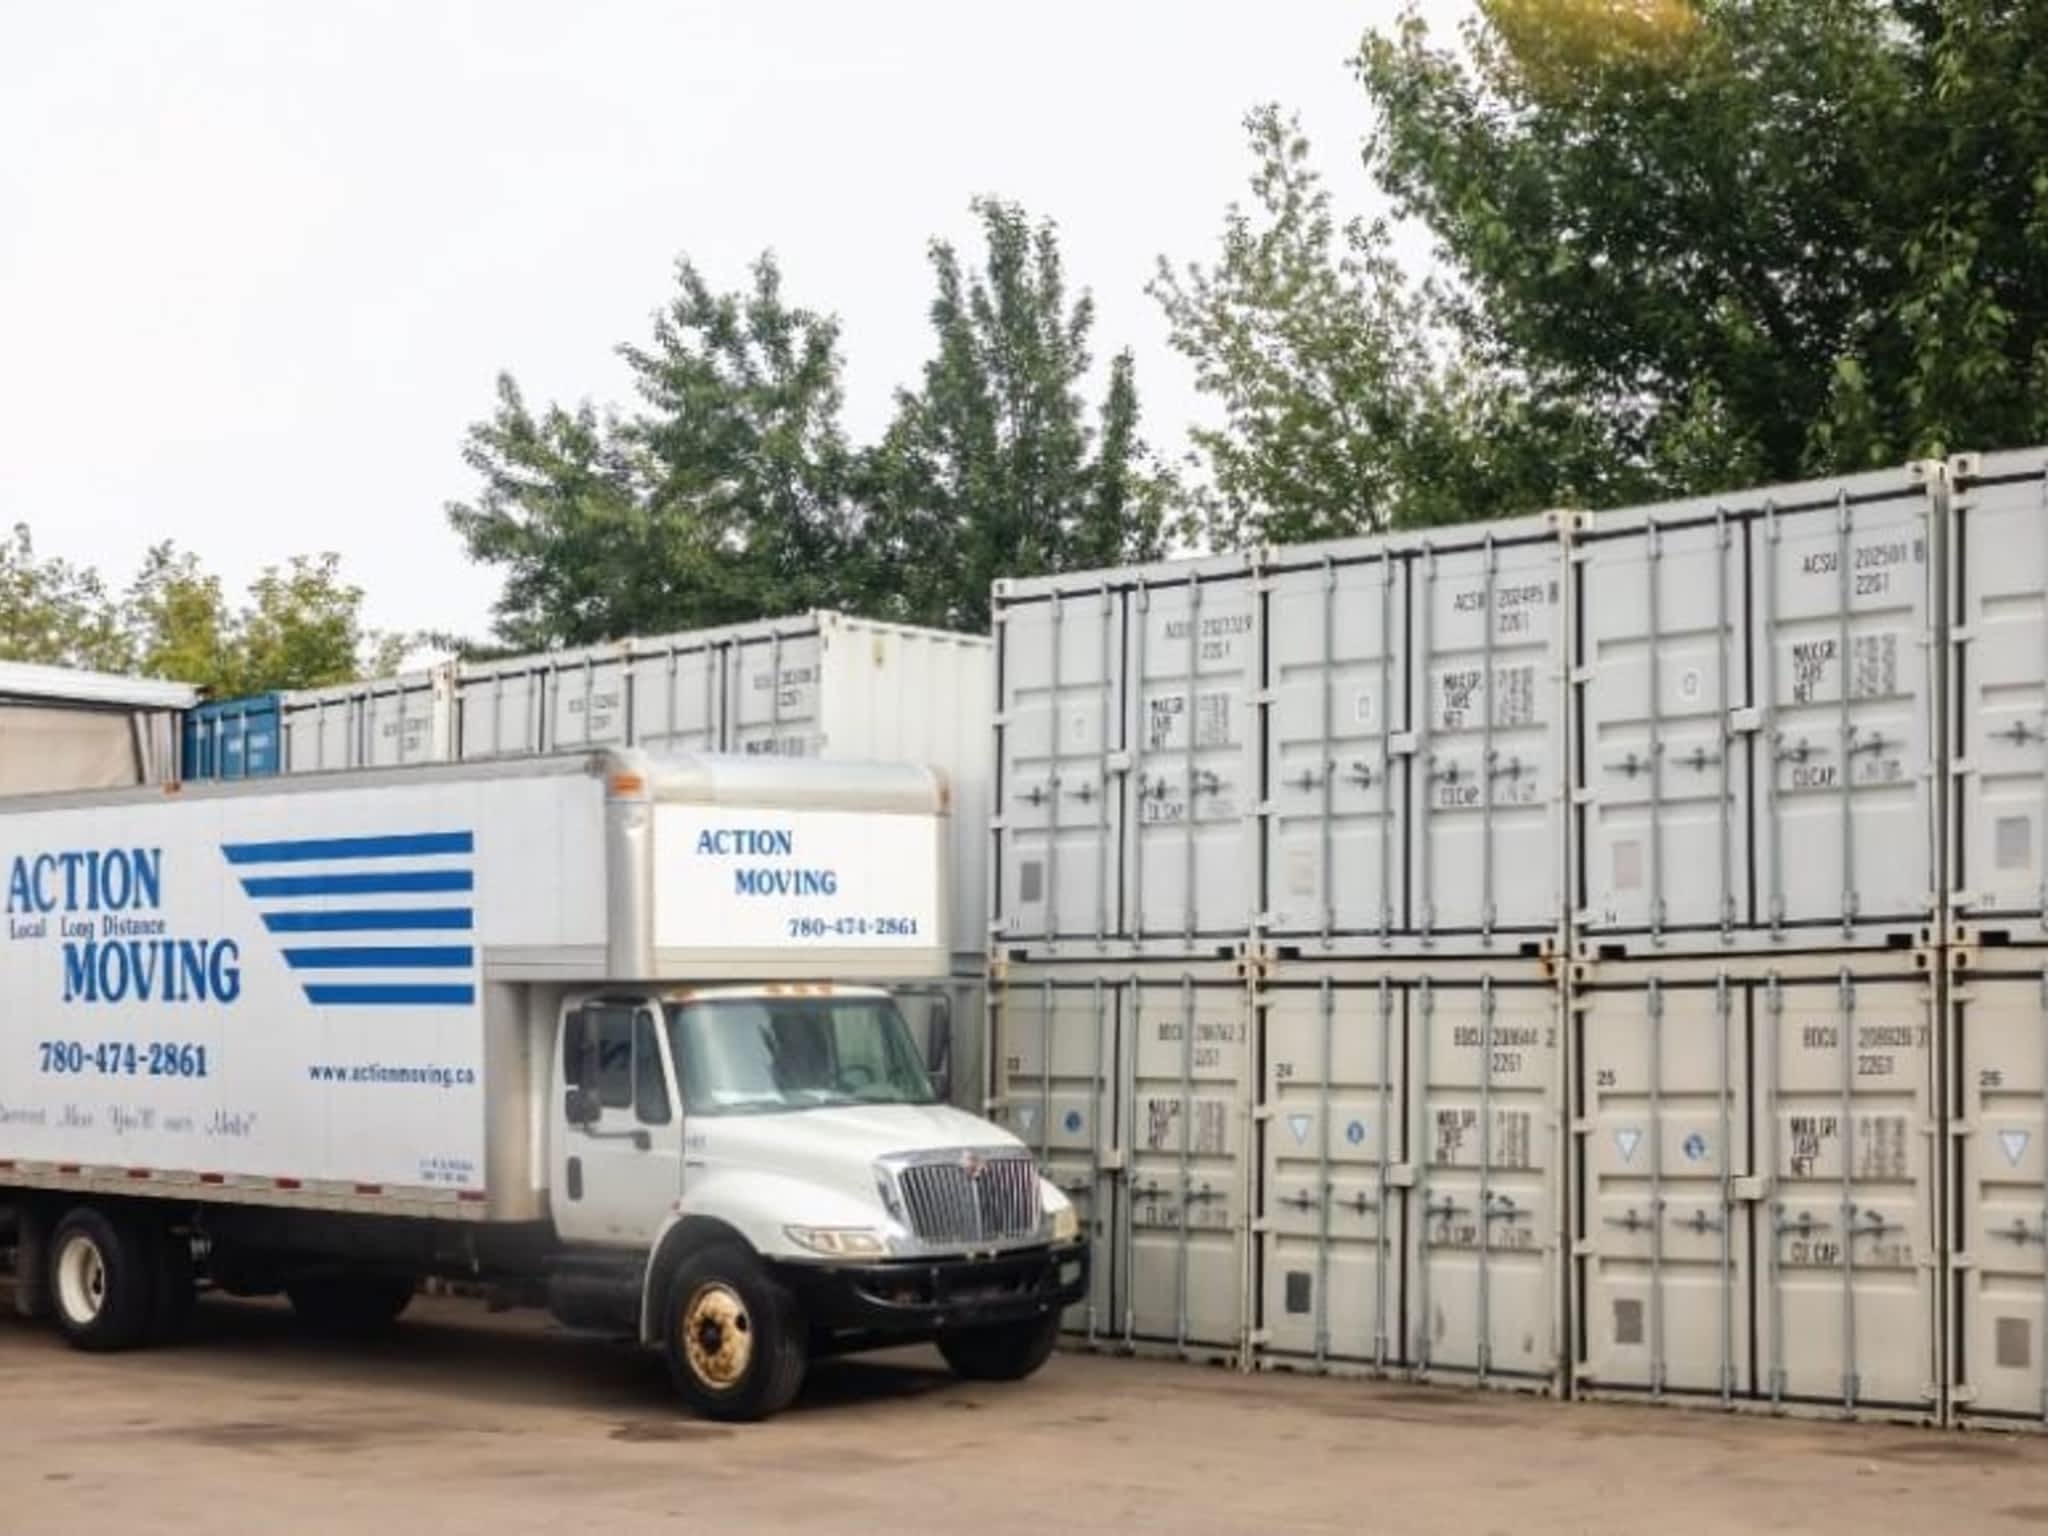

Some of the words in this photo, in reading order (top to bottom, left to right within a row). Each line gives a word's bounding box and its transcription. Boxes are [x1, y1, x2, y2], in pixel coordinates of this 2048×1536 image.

[697, 830, 792, 855] ACTION
[7, 849, 161, 913] ACTION
[734, 869, 837, 896] MOVING
[10, 918, 47, 939] Local
[61, 916, 95, 940] Long
[103, 914, 165, 936] Distance
[788, 917, 918, 937] 780-474-2861
[63, 939, 240, 1004] MOVING
[40, 1042, 207, 1076] 780-474-2861
[1275, 1063, 1293, 1078] 24
[309, 1065, 474, 1089] www.actionmoving.ca
[1597, 1070, 1616, 1086] 25
[1980, 1070, 2002, 1086] 26
